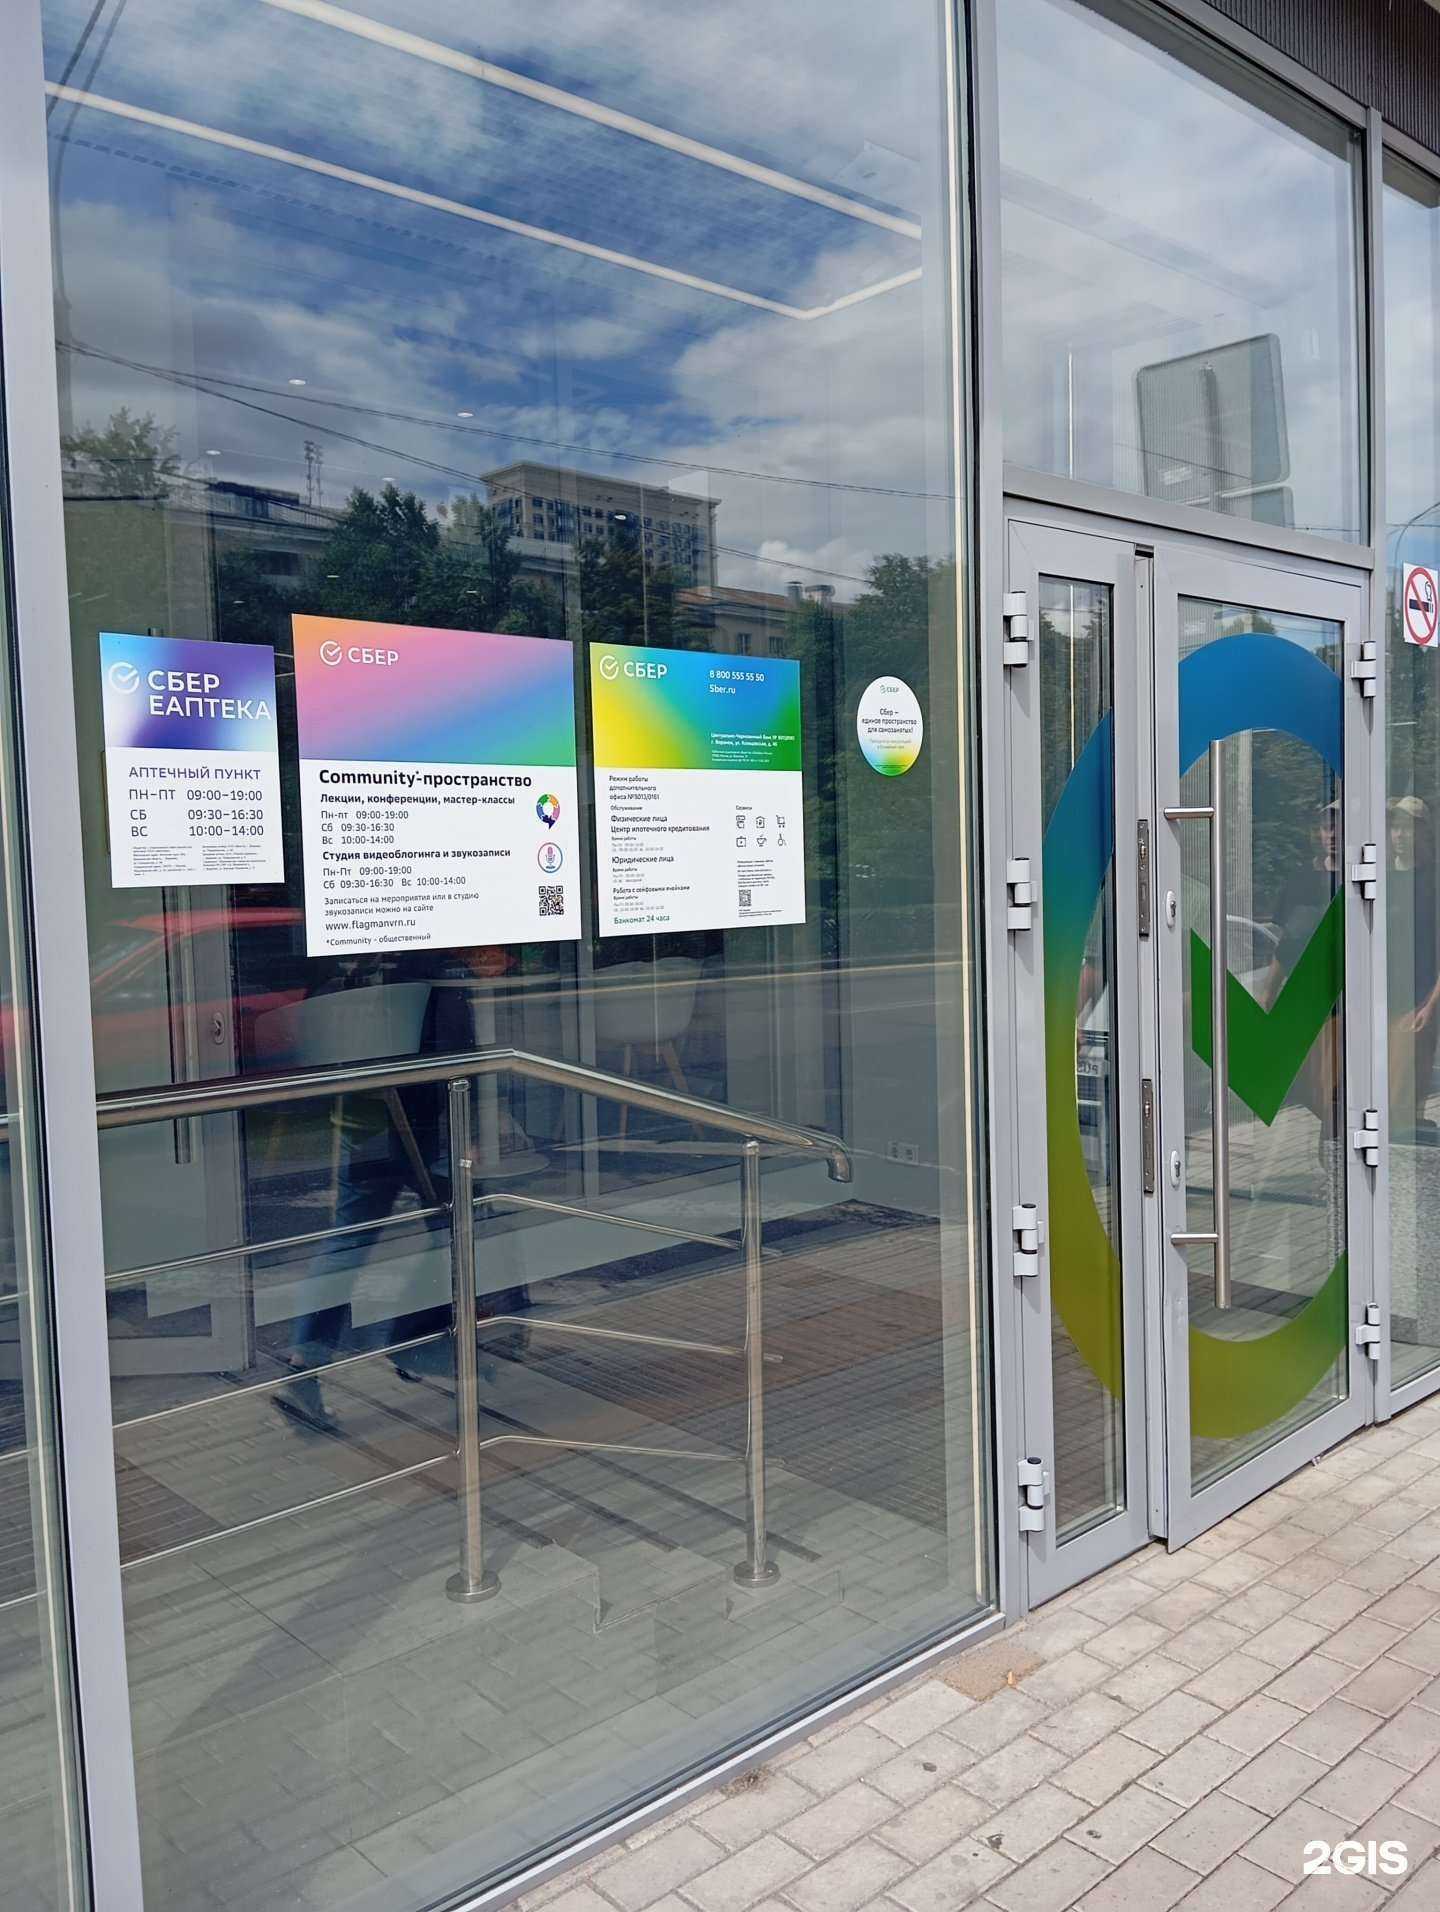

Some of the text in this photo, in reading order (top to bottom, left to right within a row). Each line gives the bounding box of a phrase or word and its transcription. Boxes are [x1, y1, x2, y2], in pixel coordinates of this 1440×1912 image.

[348, 647, 399, 666] СБЕР
[624, 661, 667, 679] СБЕР
[710, 670, 765, 682] 8 800 555 55 50
[148, 670, 220, 694] СБЕР
[150, 695, 272, 720] ЕАПТЕКА
[129, 766, 261, 780] АПТЕЧНЫЙ ПУНКТ
[129, 789, 263, 801] ПН-ПТ 09:00-19:00
[320, 794, 515, 805] Лекции, конференции, мастер-классы
[130, 809, 264, 820] СБ 09:30-16:30
[321, 810, 409, 820] Пн-пт 09:00-19:00
[131, 826, 264, 837] ВС 10:00-14:00
[321, 823, 394, 832] Сб 09:30-16:30
[611, 826, 630, 834] Центр
[668, 825, 710, 833] кредитования
[322, 835, 394, 845] Вс 10:00-14:00
[323, 852, 361, 861] Студия
[364, 850, 441, 860] видеоблогинга
[451, 850, 511, 858] звукозаписи
[612, 856, 657, 864] Юридические
[323, 866, 412, 877] Пн-Пт 09:00-19:00
[323, 877, 466, 889] Сб 09:30-16:30 Вс 10:00-14:00
[324, 897, 368, 905] Записаться
[382, 894, 431, 903] мероприятия
[454, 892, 479, 901] студию
[325, 907, 373, 917] звукозаписи
[376, 906, 400, 914] можно
[414, 904, 434, 912] сайте
[326, 919, 416, 931] www.flagmanvrn.ru
[379, 933, 431, 944] общественный
